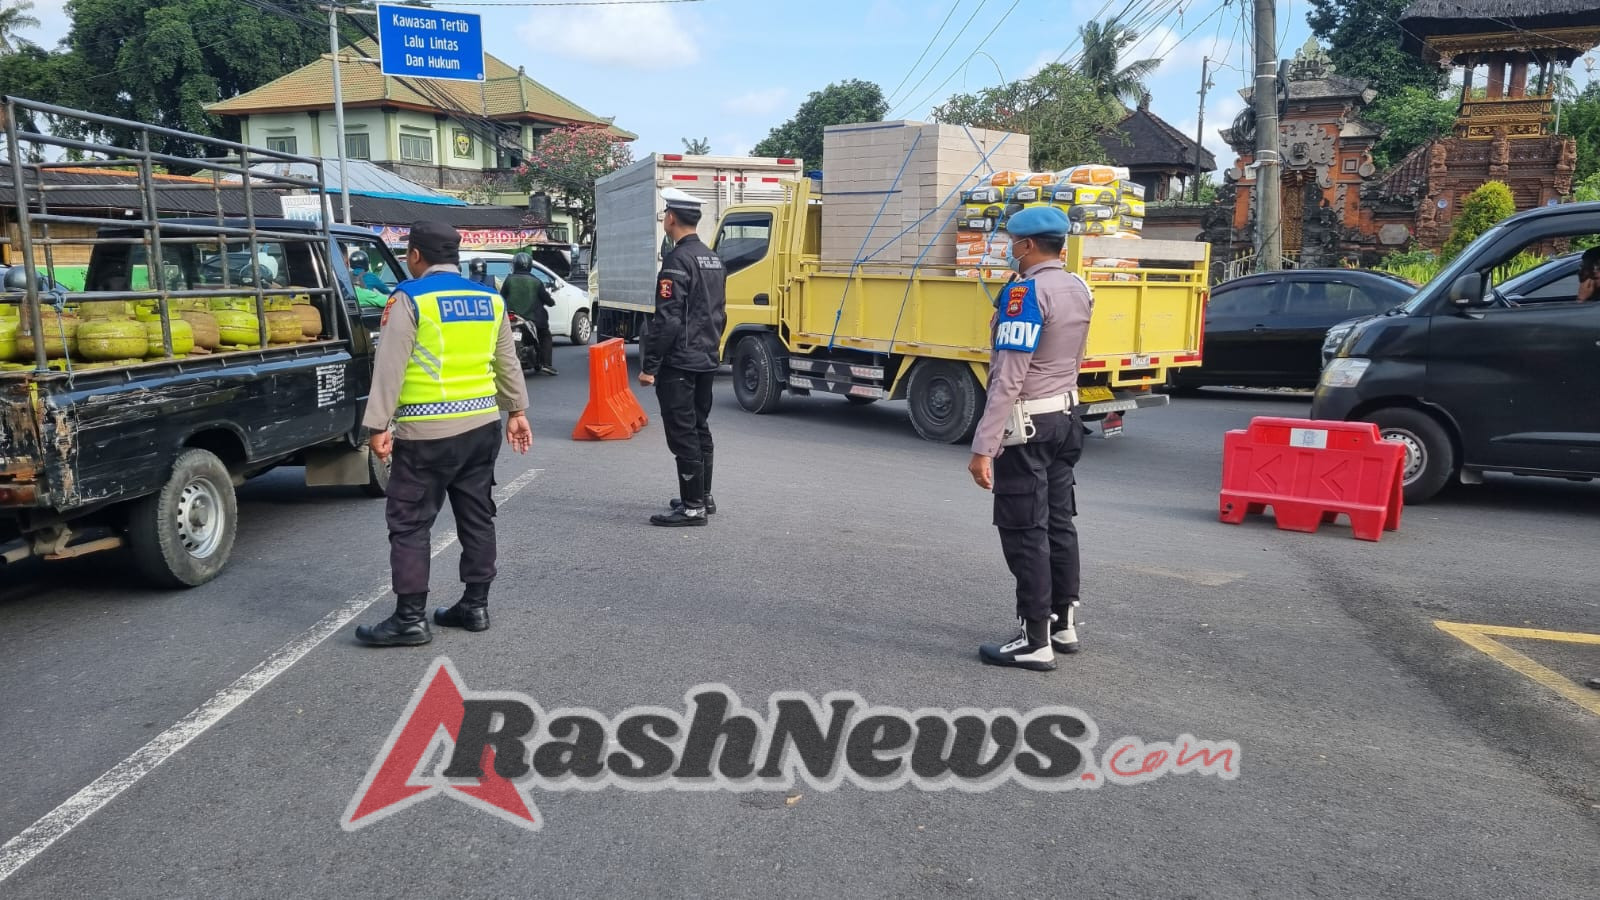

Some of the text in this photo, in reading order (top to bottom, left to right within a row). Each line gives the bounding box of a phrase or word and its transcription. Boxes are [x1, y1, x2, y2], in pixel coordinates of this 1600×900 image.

[392, 14, 469, 33] Kawasan Tertib
[404, 35, 459, 51] Lalu Lintas
[406, 54, 460, 70] Dan Hukum
[442, 300, 493, 317] POLISI
